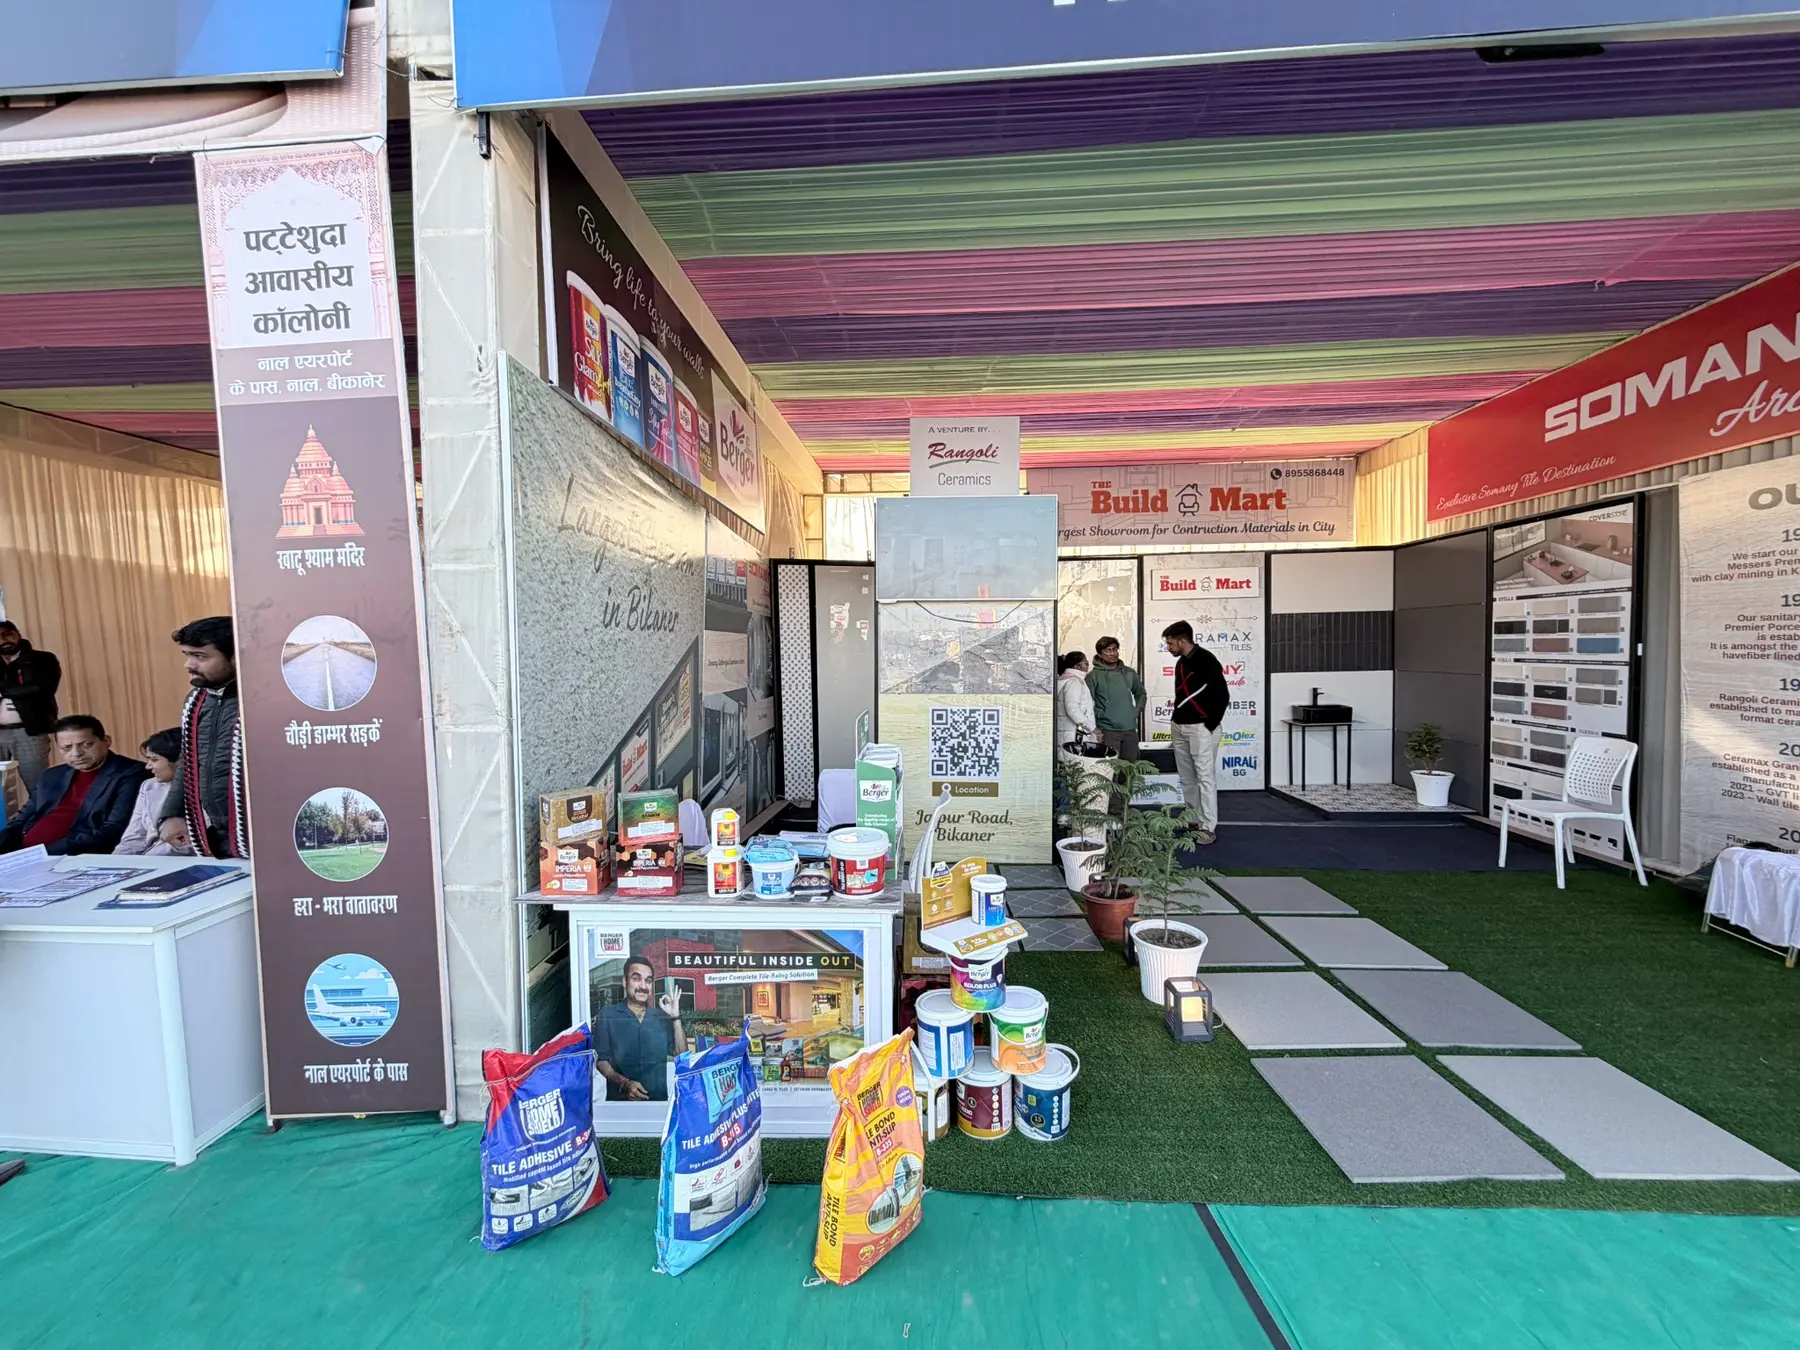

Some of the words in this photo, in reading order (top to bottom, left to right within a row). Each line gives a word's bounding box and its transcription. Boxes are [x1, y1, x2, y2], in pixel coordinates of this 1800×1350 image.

[243, 221, 347, 255] पट्टेशुदा
[244, 260, 354, 294] आवासीय
[577, 205, 624, 289] Bring
[625, 266, 646, 310] life
[658, 315, 682, 349] your
[682, 344, 704, 380] walls
[253, 300, 351, 334] कॉलोनी
[256, 355, 290, 371] नाल
[293, 349, 353, 369] एयरपोर्ट
[229, 379, 245, 396] के
[327, 372, 386, 390] बीकानेर
[1544, 312, 1800, 443] SOMAN
[720, 420, 755, 485] Berger
[928, 442, 999, 463] Rangoli
[938, 472, 992, 486] Ceramics
[1285, 468, 1345, 477] 8955868448
[1478, 480, 1520, 499] Somany
[1542, 454, 1617, 483] Destination
[1091, 488, 1168, 514] Build
[1209, 487, 1287, 511] Mart
[1089, 525, 1150, 537] Showroom
[1150, 523, 1169, 539] for
[1241, 521, 1295, 534] Materials
[1298, 521, 1309, 532] in
[1313, 521, 1336, 536] City
[276, 549, 306, 575] खाटू
[304, 548, 334, 568] श्याम
[1732, 552, 1748, 561] We
[1751, 550, 1776, 560] start
[1779, 549, 1798, 557] our
[1727, 559, 1772, 571] Messers
[1691, 574, 1712, 583] with
[1714, 573, 1735, 582] clay
[1737, 569, 1774, 580] mining
[1777, 568, 1788, 577] in
[1160, 580, 1197, 592] Build
[1216, 578, 1252, 590] Mart
[602, 587, 621, 629] in
[627, 585, 680, 633] Bikaner
[1737, 614, 1757, 622] Our
[1724, 623, 1765, 632] Premier
[1757, 633, 1767, 641] is
[1710, 642, 1717, 650] It
[1719, 642, 1728, 650] is
[1730, 642, 1777, 652] amongst
[1780, 642, 1798, 651] the
[1722, 651, 1771, 660] havefiber
[1719, 693, 1758, 704] Rangoli
[1709, 702, 1768, 714] established
[1771, 706, 1782, 715] to
[1740, 713, 1775, 724] format
[284, 719, 312, 749] चौड़ी
[349, 718, 383, 747] सड़कें
[1723, 753, 1769, 767] Ceramax
[1233, 769, 1247, 777] BG
[1711, 761, 1771, 777] established
[1773, 770, 1787, 779] as
[862, 788, 889, 798] Berger
[955, 786, 989, 794] Location
[1721, 788, 1745, 800] 2023
[1756, 795, 1779, 807] Wall
[1729, 781, 1754, 793] 2021
[1766, 789, 1790, 799] GVT
[915, 809, 964, 829] Japur
[968, 809, 1013, 825] Road,
[934, 826, 995, 842] Bikaner
[293, 897, 313, 916] हरा
[323, 896, 343, 915] भरा
[345, 895, 398, 914] वातावरण
[674, 955, 756, 966] BEAUTIFUL
[763, 956, 814, 966] INSIDE
[820, 956, 850, 966] OUT
[728, 974, 757, 982] Complete
[303, 1065, 328, 1083] नाल
[329, 1058, 371, 1083] एयरपोर्ट
[373, 1057, 385, 1082] के
[387, 1063, 409, 1082] पास
[857, 1081, 881, 1100] BERGER
[862, 1090, 880, 1108] HOME
[528, 1115, 561, 1137] SHIELD
[874, 1111, 895, 1134] BOND
[682, 1136, 702, 1150] TILE
[492, 1160, 516, 1175] TILE
[519, 1140, 573, 1171] ADHESIVE
[832, 1196, 840, 1215] TILE
[824, 1191, 833, 1240] ANTI-SLIP
[829, 1215, 839, 1247] BOND
